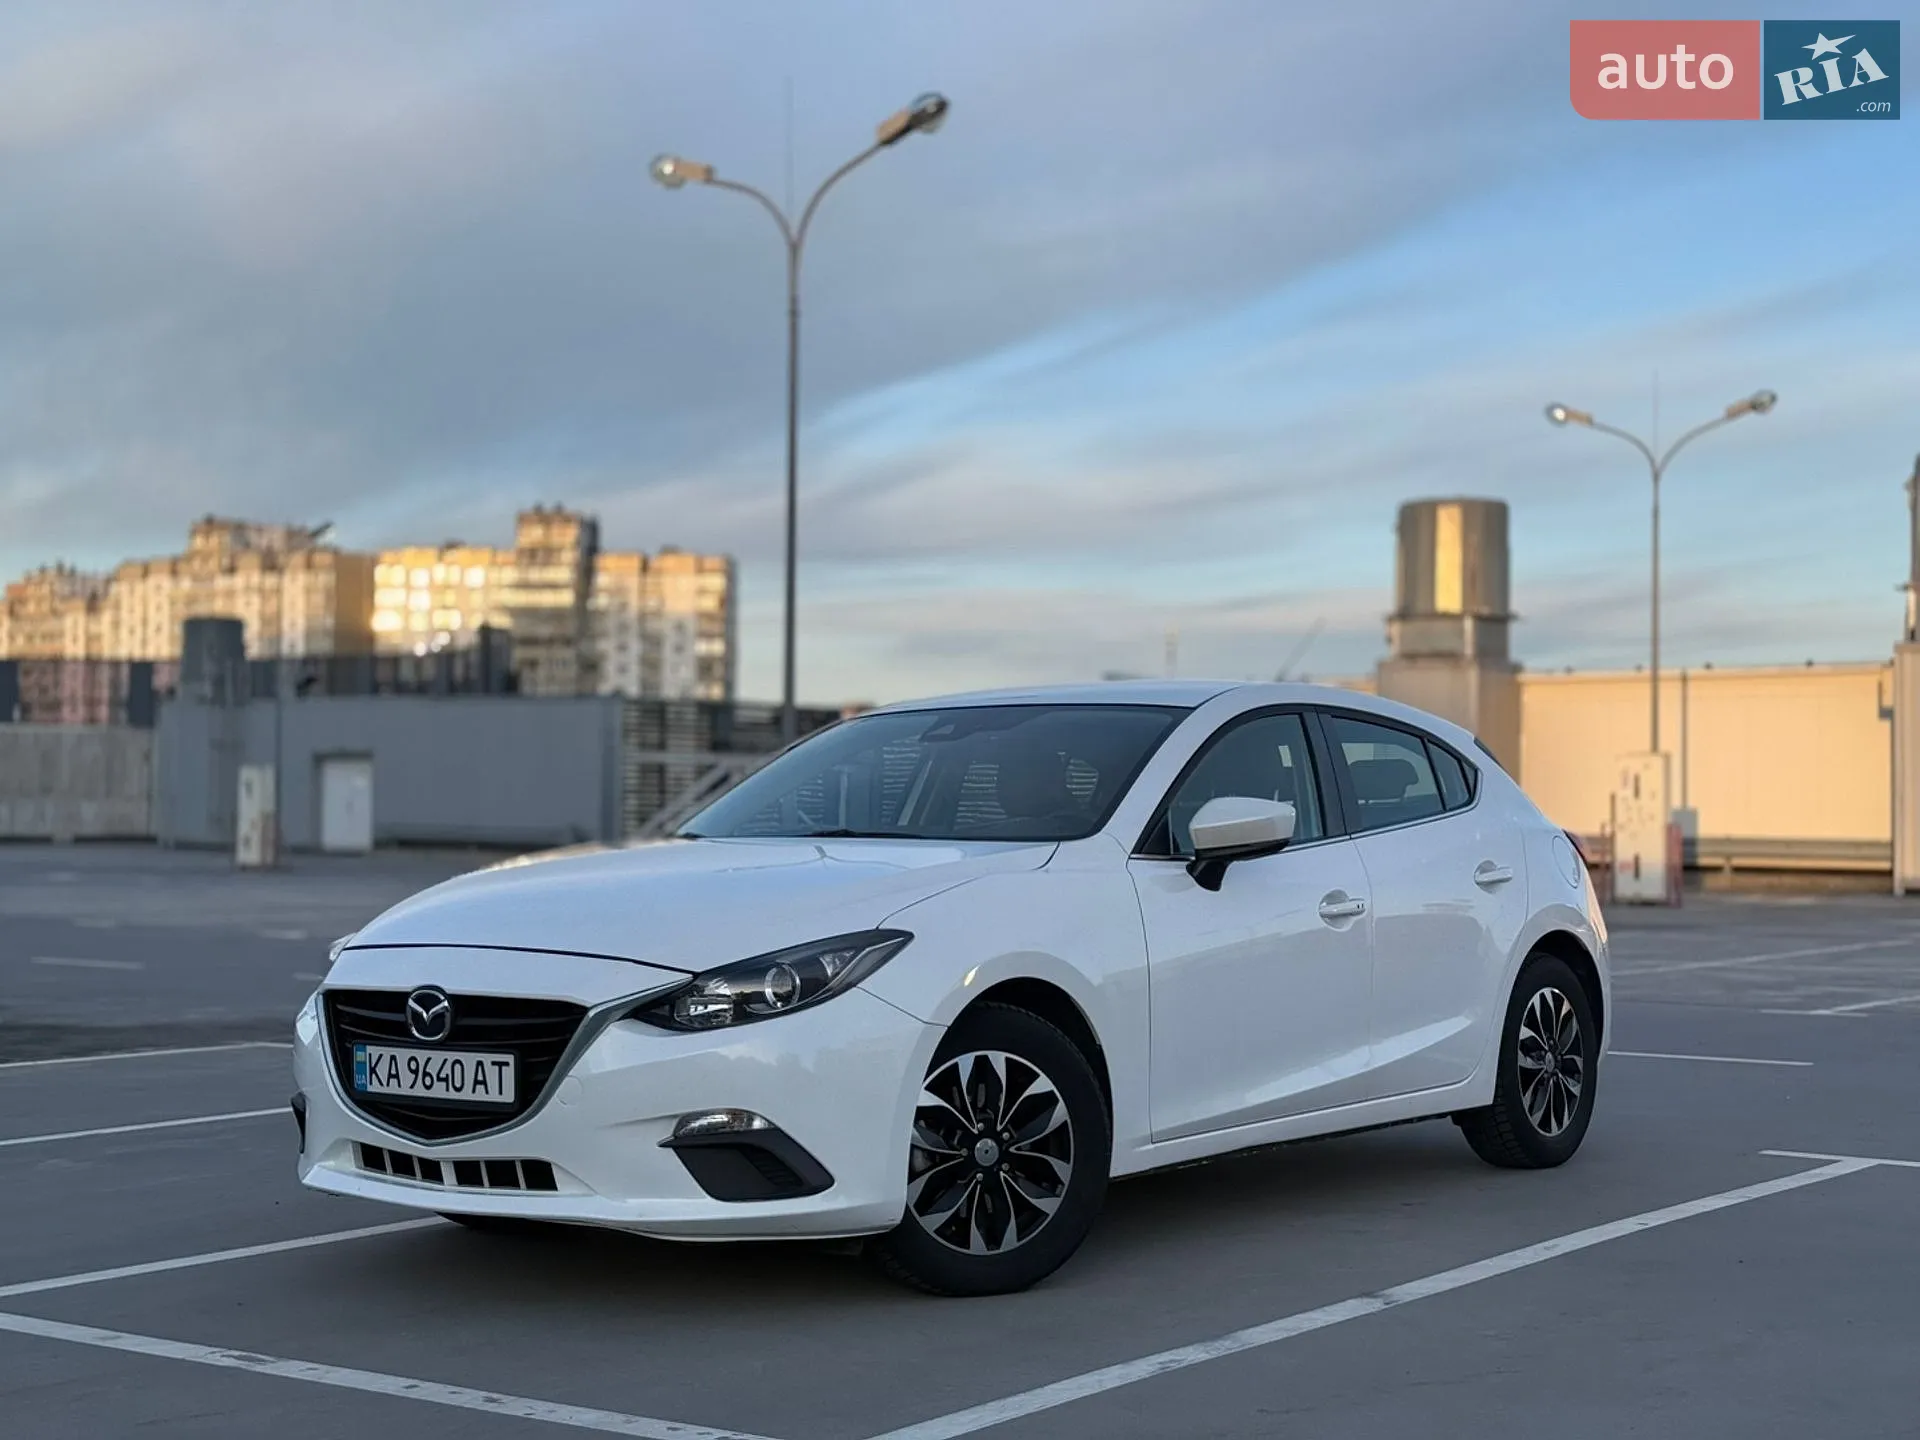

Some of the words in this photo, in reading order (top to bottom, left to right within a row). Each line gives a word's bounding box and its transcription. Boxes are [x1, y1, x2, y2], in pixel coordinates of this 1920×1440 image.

[368, 1052, 402, 1089] KA
[407, 1055, 465, 1093] 9640
[471, 1059, 511, 1096] AT
